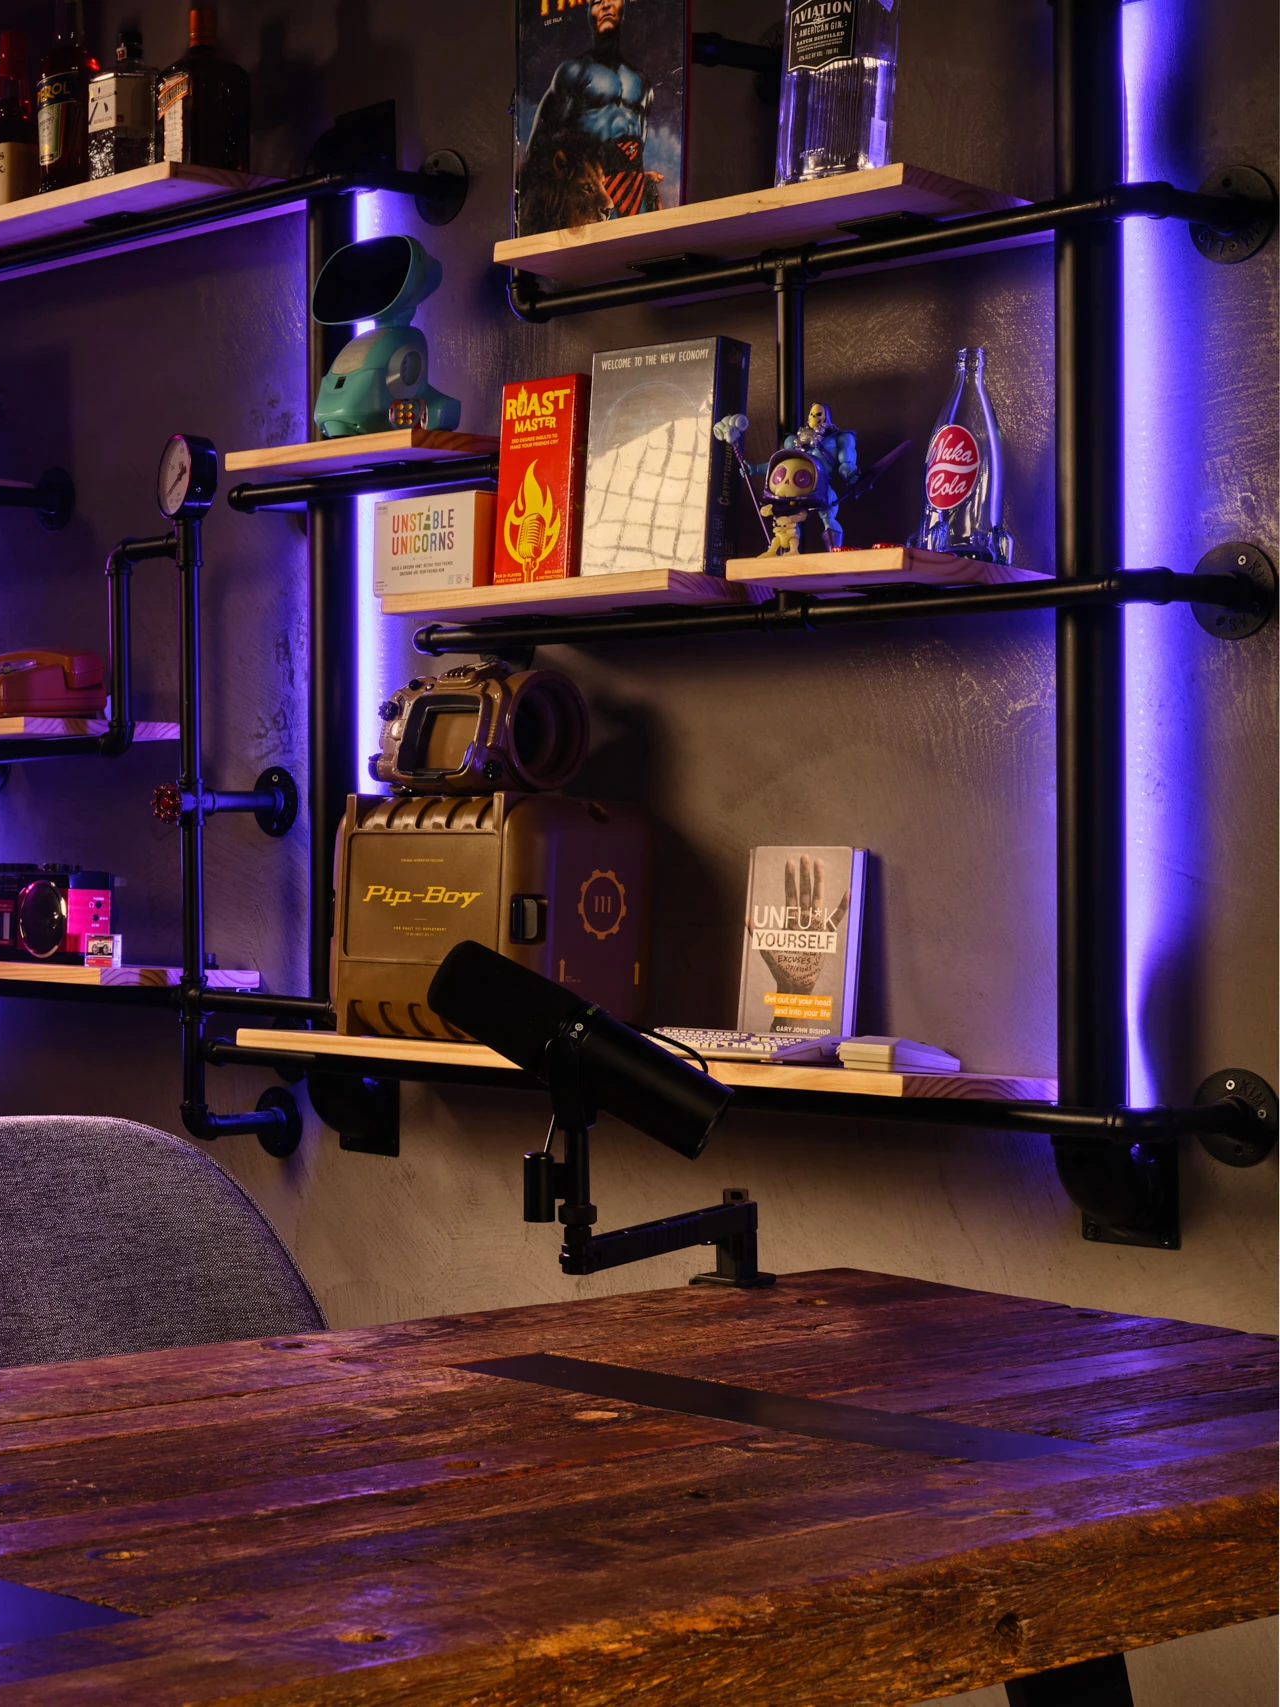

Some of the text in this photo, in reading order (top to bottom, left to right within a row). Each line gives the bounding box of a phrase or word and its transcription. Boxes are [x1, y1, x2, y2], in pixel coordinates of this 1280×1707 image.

[794, 1, 852, 26] AVIATION
[799, 23, 829, 37] AMERICAN
[37, 81, 71, 104] PEROL
[601, 348, 709, 371] WELCOME TO THE NEW ECONOMY
[505, 384, 571, 420] ROAST
[514, 416, 557, 434] MASTER
[928, 433, 973, 467] Nuka
[929, 473, 968, 498] Cola
[392, 504, 455, 534] UNSTABLE
[391, 531, 455, 556] UNICORNS
[362, 885, 481, 909] Pip-Boy
[755, 932, 835, 950] YOURSELF
[777, 955, 811, 965] EXCUSES
[774, 1007, 788, 1015] and
[789, 1007, 802, 1016] into
[820, 1009, 831, 1017] life
[814, 998, 831, 1006] head
